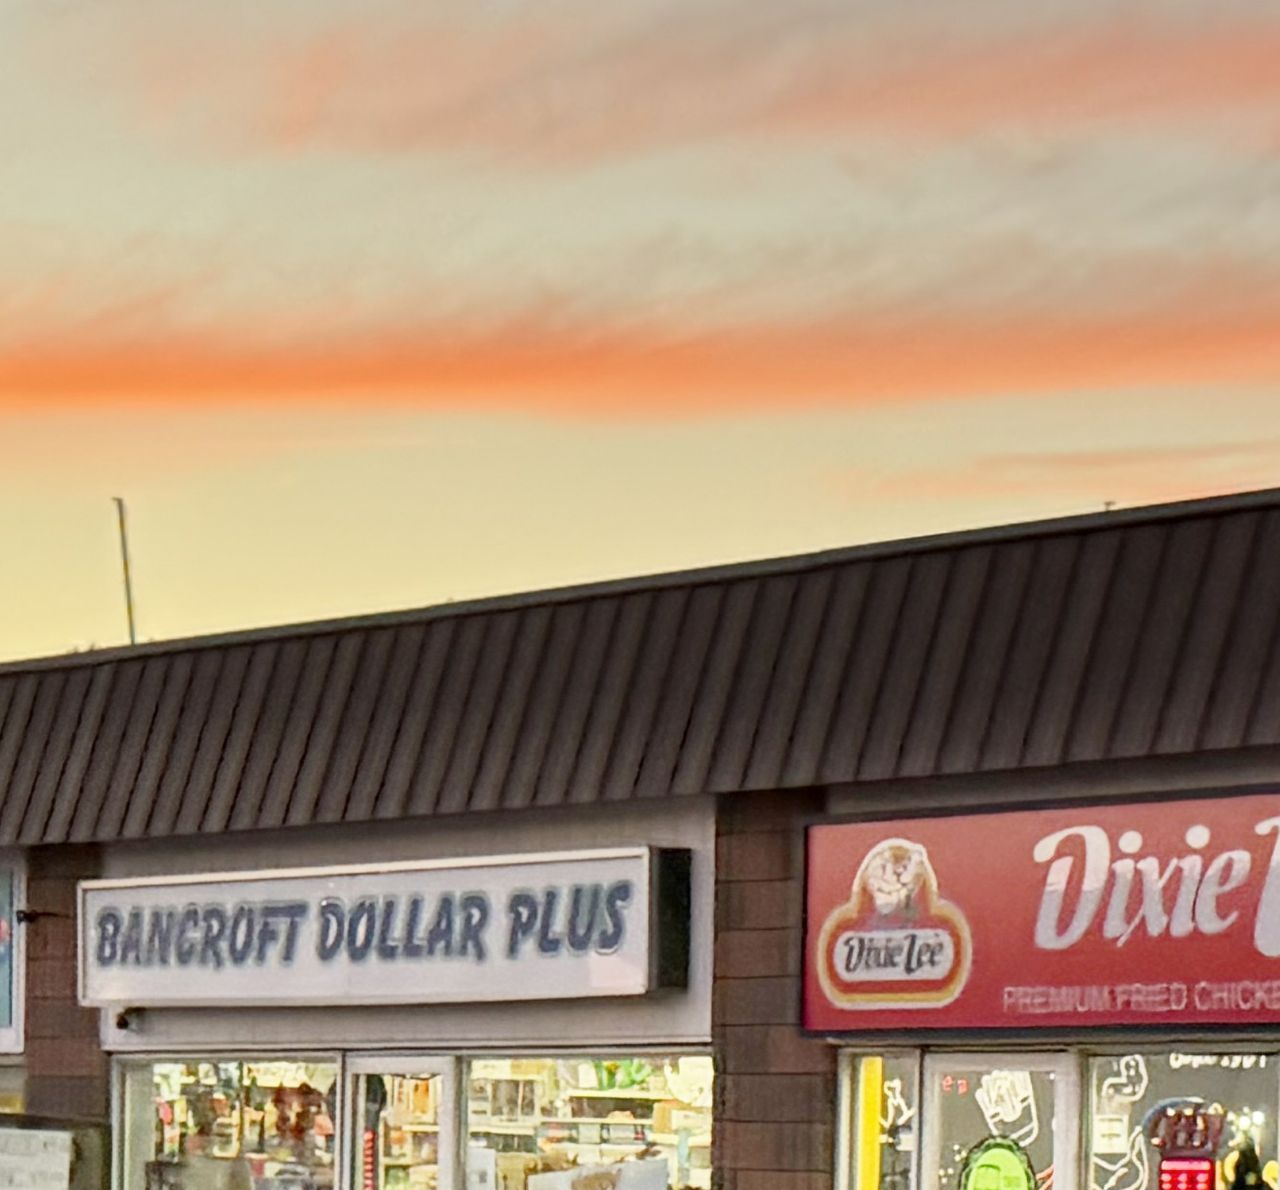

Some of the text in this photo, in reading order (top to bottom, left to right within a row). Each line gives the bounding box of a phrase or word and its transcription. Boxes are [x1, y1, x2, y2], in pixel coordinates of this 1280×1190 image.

[1033, 824, 1252, 951] Dixie
[95, 880, 634, 970] BANCROFT DOLLAR PLUS
[843, 932, 945, 975] Dixie Lee
[1003, 986, 1111, 1014] PREMIUM
[1118, 982, 1188, 1012] FRIED
